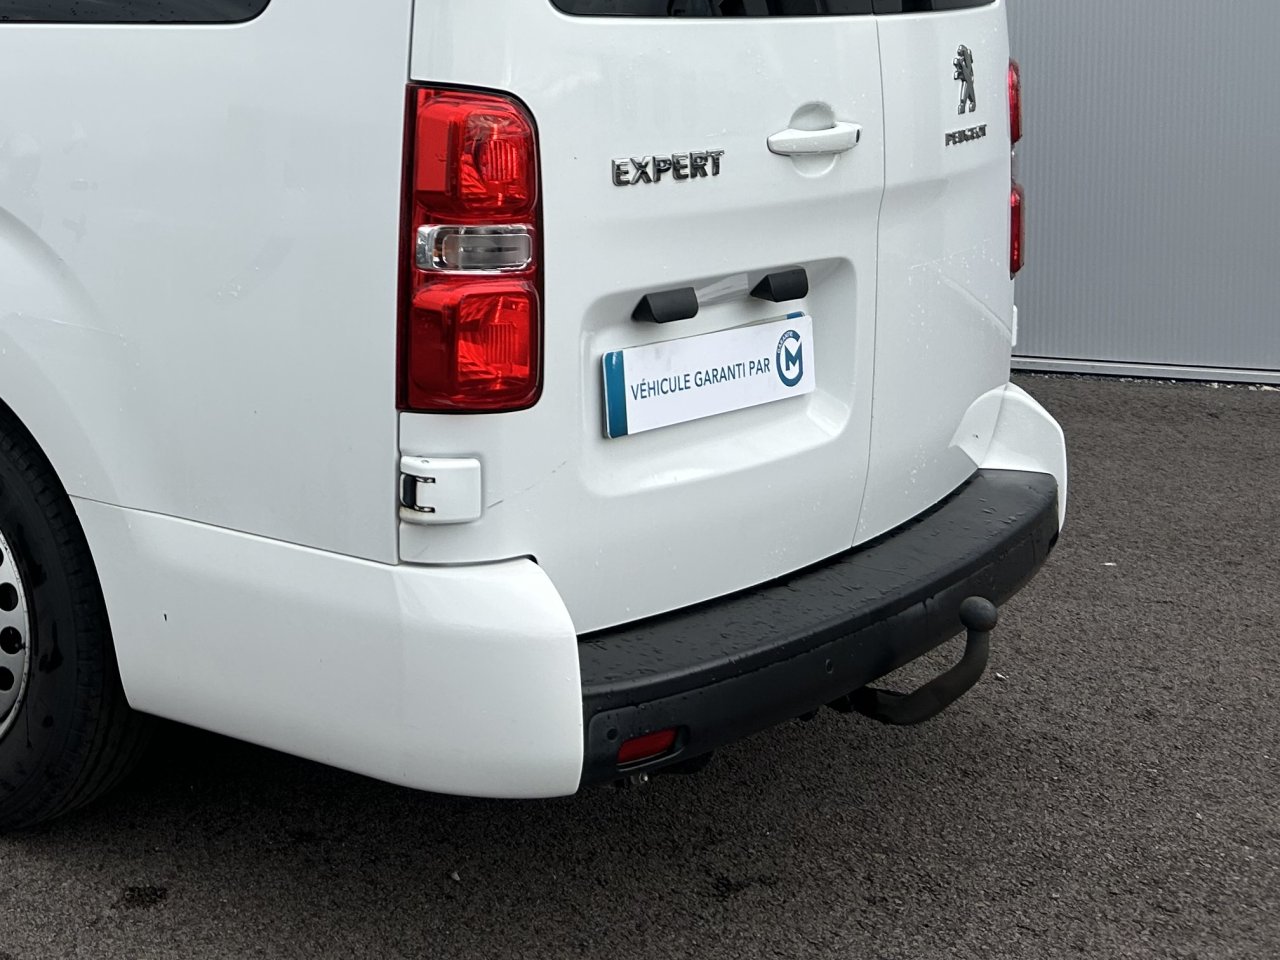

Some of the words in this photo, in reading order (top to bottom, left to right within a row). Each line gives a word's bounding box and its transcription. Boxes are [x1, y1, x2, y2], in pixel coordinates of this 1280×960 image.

[612, 149, 724, 186] EXPERT
[631, 373, 691, 400] VÉHICULE
[694, 362, 746, 388] GARANTI
[749, 357, 771, 376] PAR
